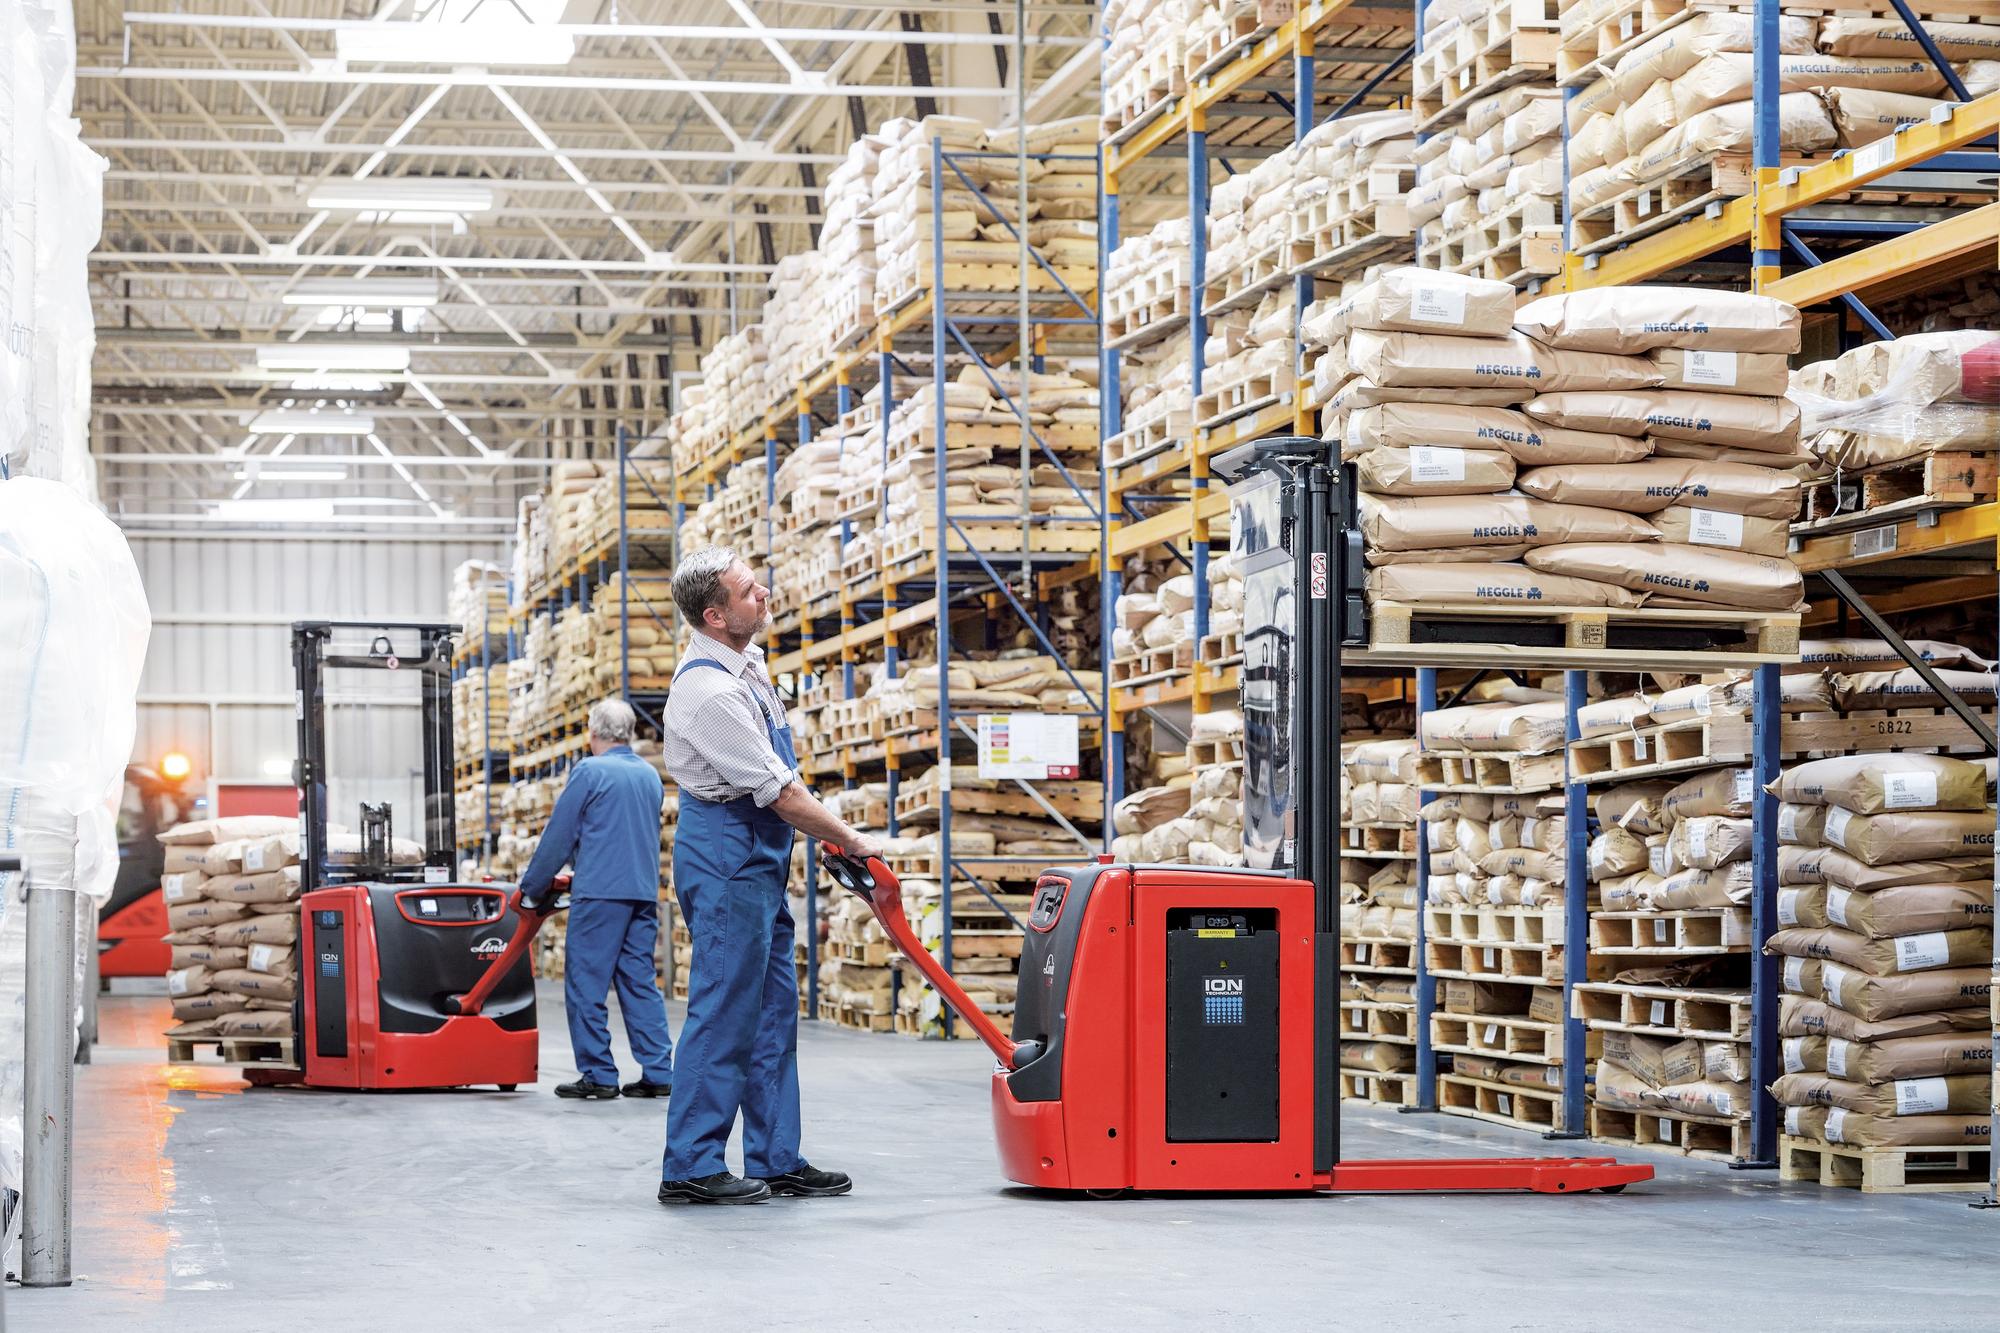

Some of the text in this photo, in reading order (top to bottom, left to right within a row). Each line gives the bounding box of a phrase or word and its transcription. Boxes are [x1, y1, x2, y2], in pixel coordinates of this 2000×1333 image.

[1877, 32, 1891, 40] Ein
[1791, 64, 1831, 73] MEGGLE
[1872, 65, 1892, 73] with
[1895, 65, 1909, 73] the
[1879, 115, 1893, 124] Ein
[1476, 364, 1523, 377] MEGGLE
[1647, 415, 1693, 428] MEGGLE
[1478, 427, 1523, 442] MEGGLE
[1473, 526, 1520, 537] MEGGLE
[1644, 573, 1691, 589] MEGGLE
[1476, 586, 1523, 598] MEGGLE
[321, 953, 338, 961] ION
[1205, 979, 1243, 992] ION
